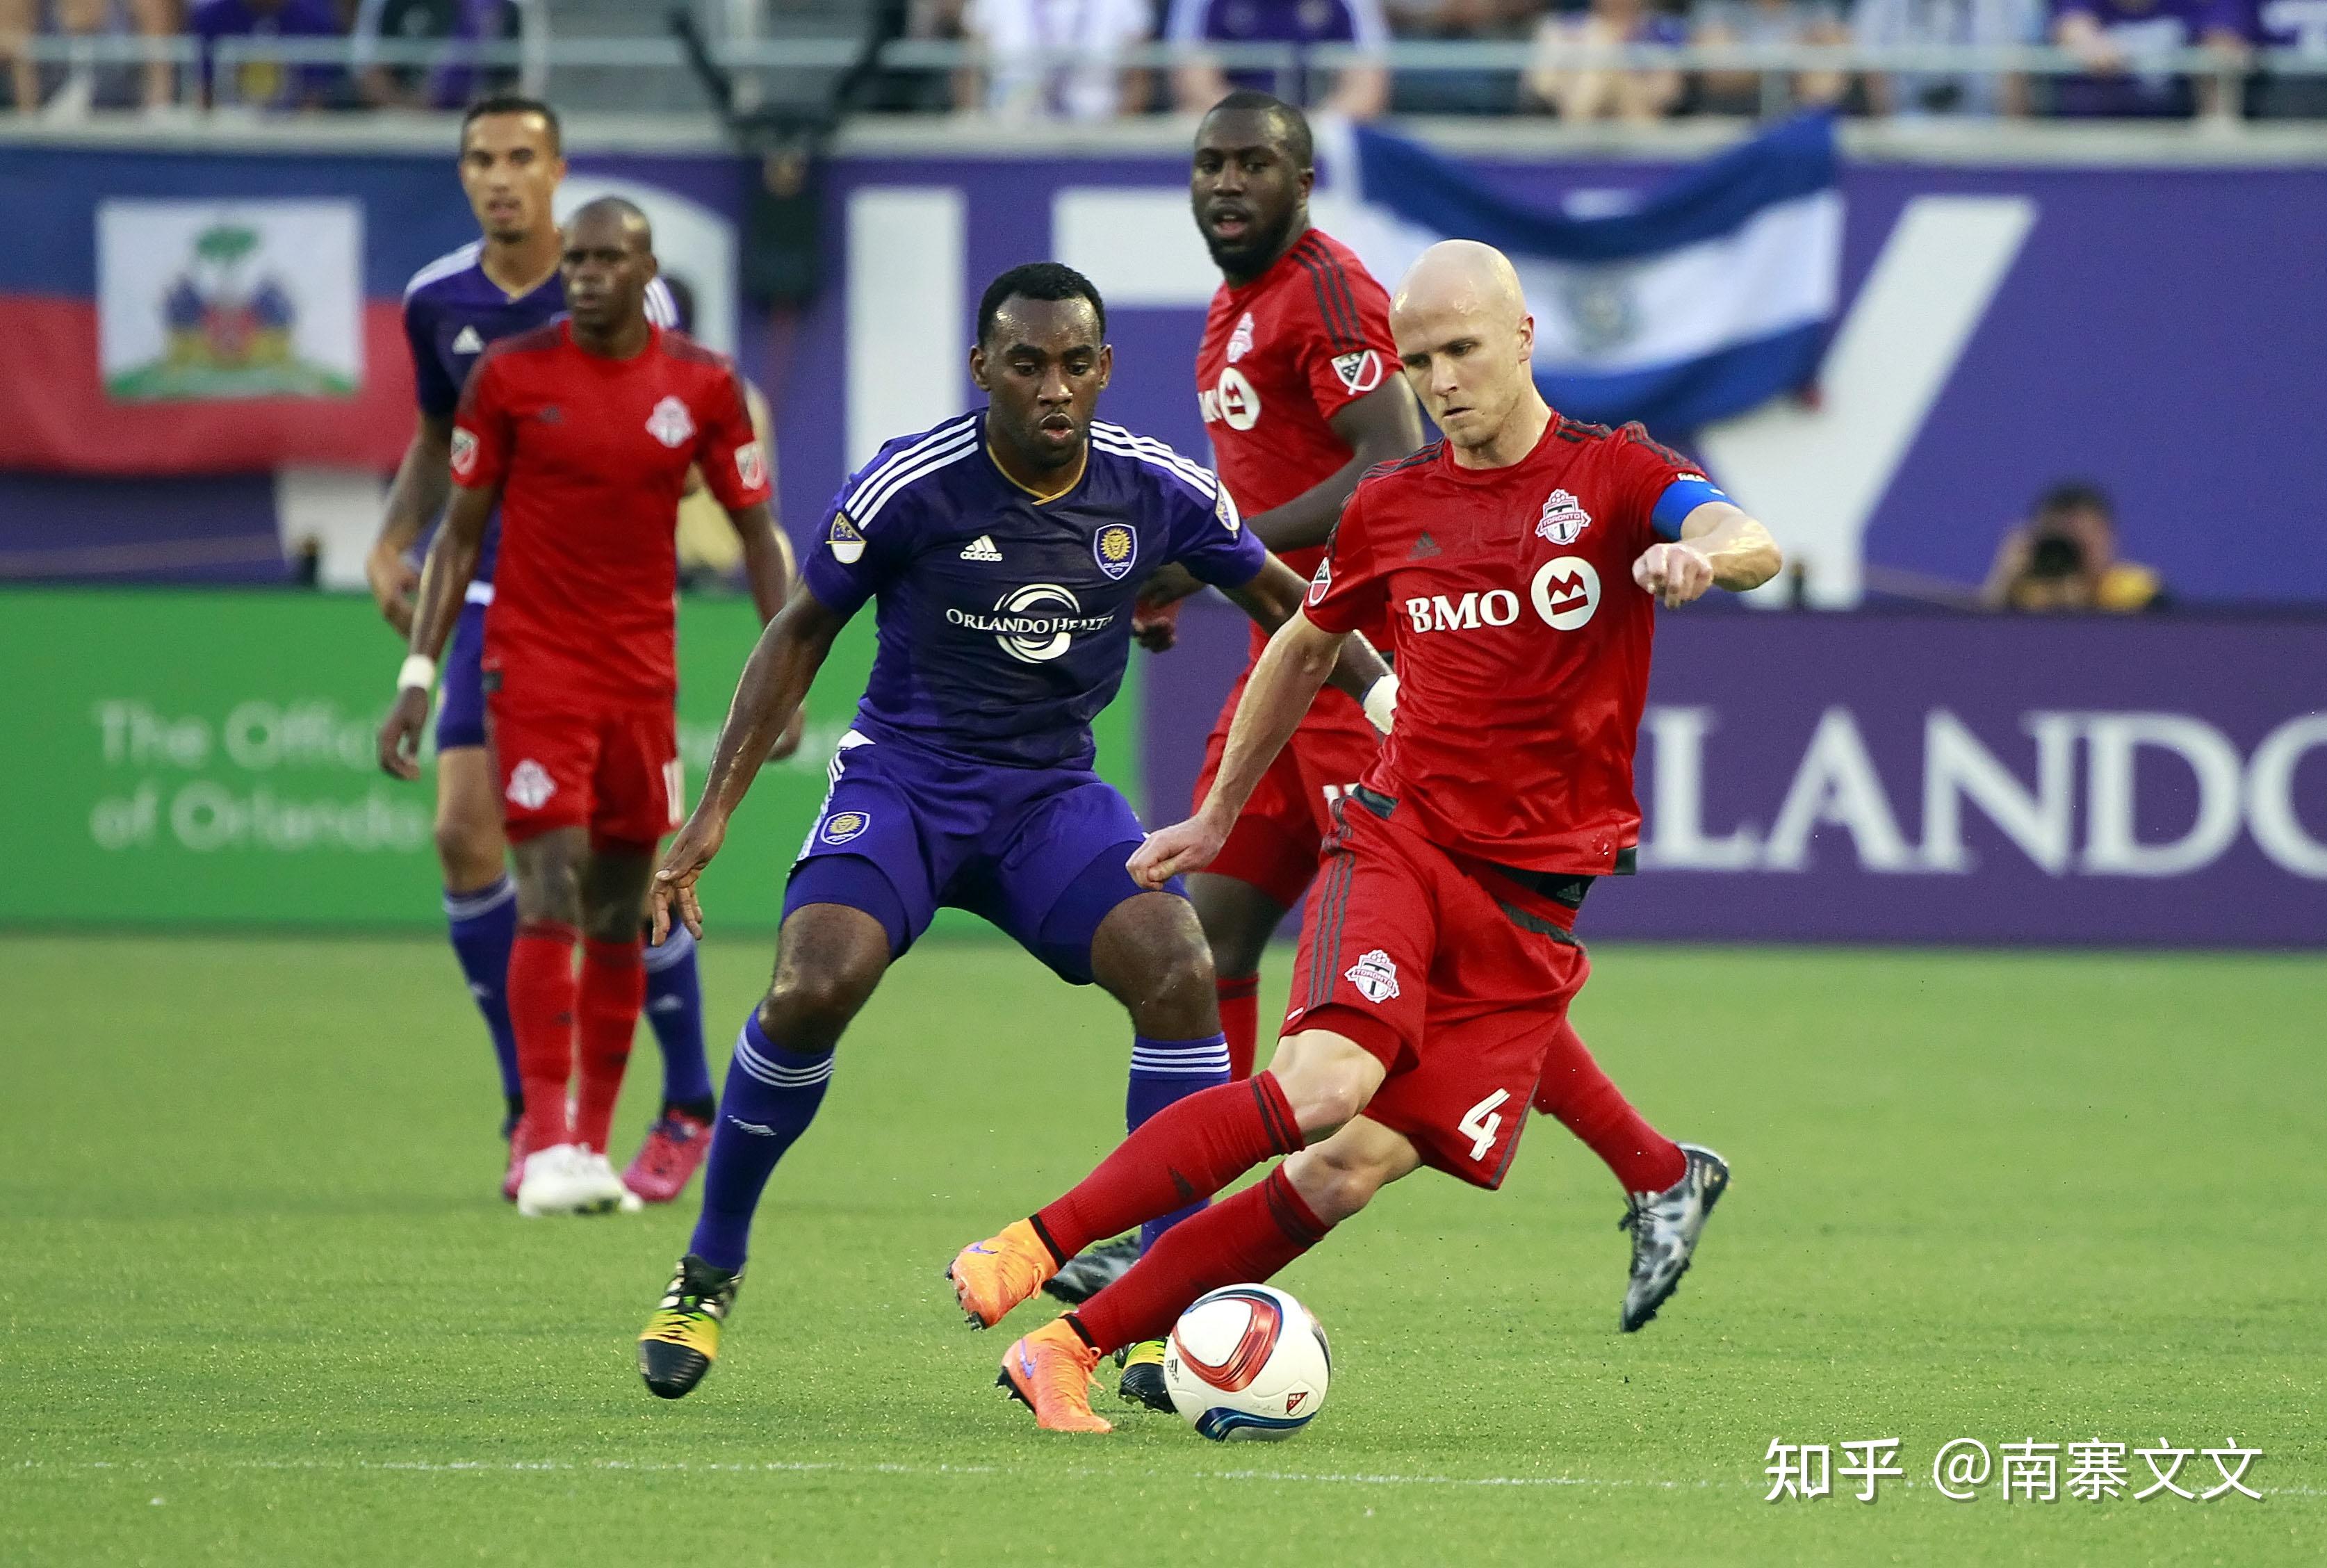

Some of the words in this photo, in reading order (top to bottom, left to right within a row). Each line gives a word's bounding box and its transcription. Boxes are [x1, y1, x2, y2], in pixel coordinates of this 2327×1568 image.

[1543, 512, 1581, 527] TORONTO
[960, 550, 1003, 562] adidas
[946, 608, 1048, 634] ORLANDO
[1406, 589, 1519, 633] BMO
[1458, 1088, 1510, 1161] 4
